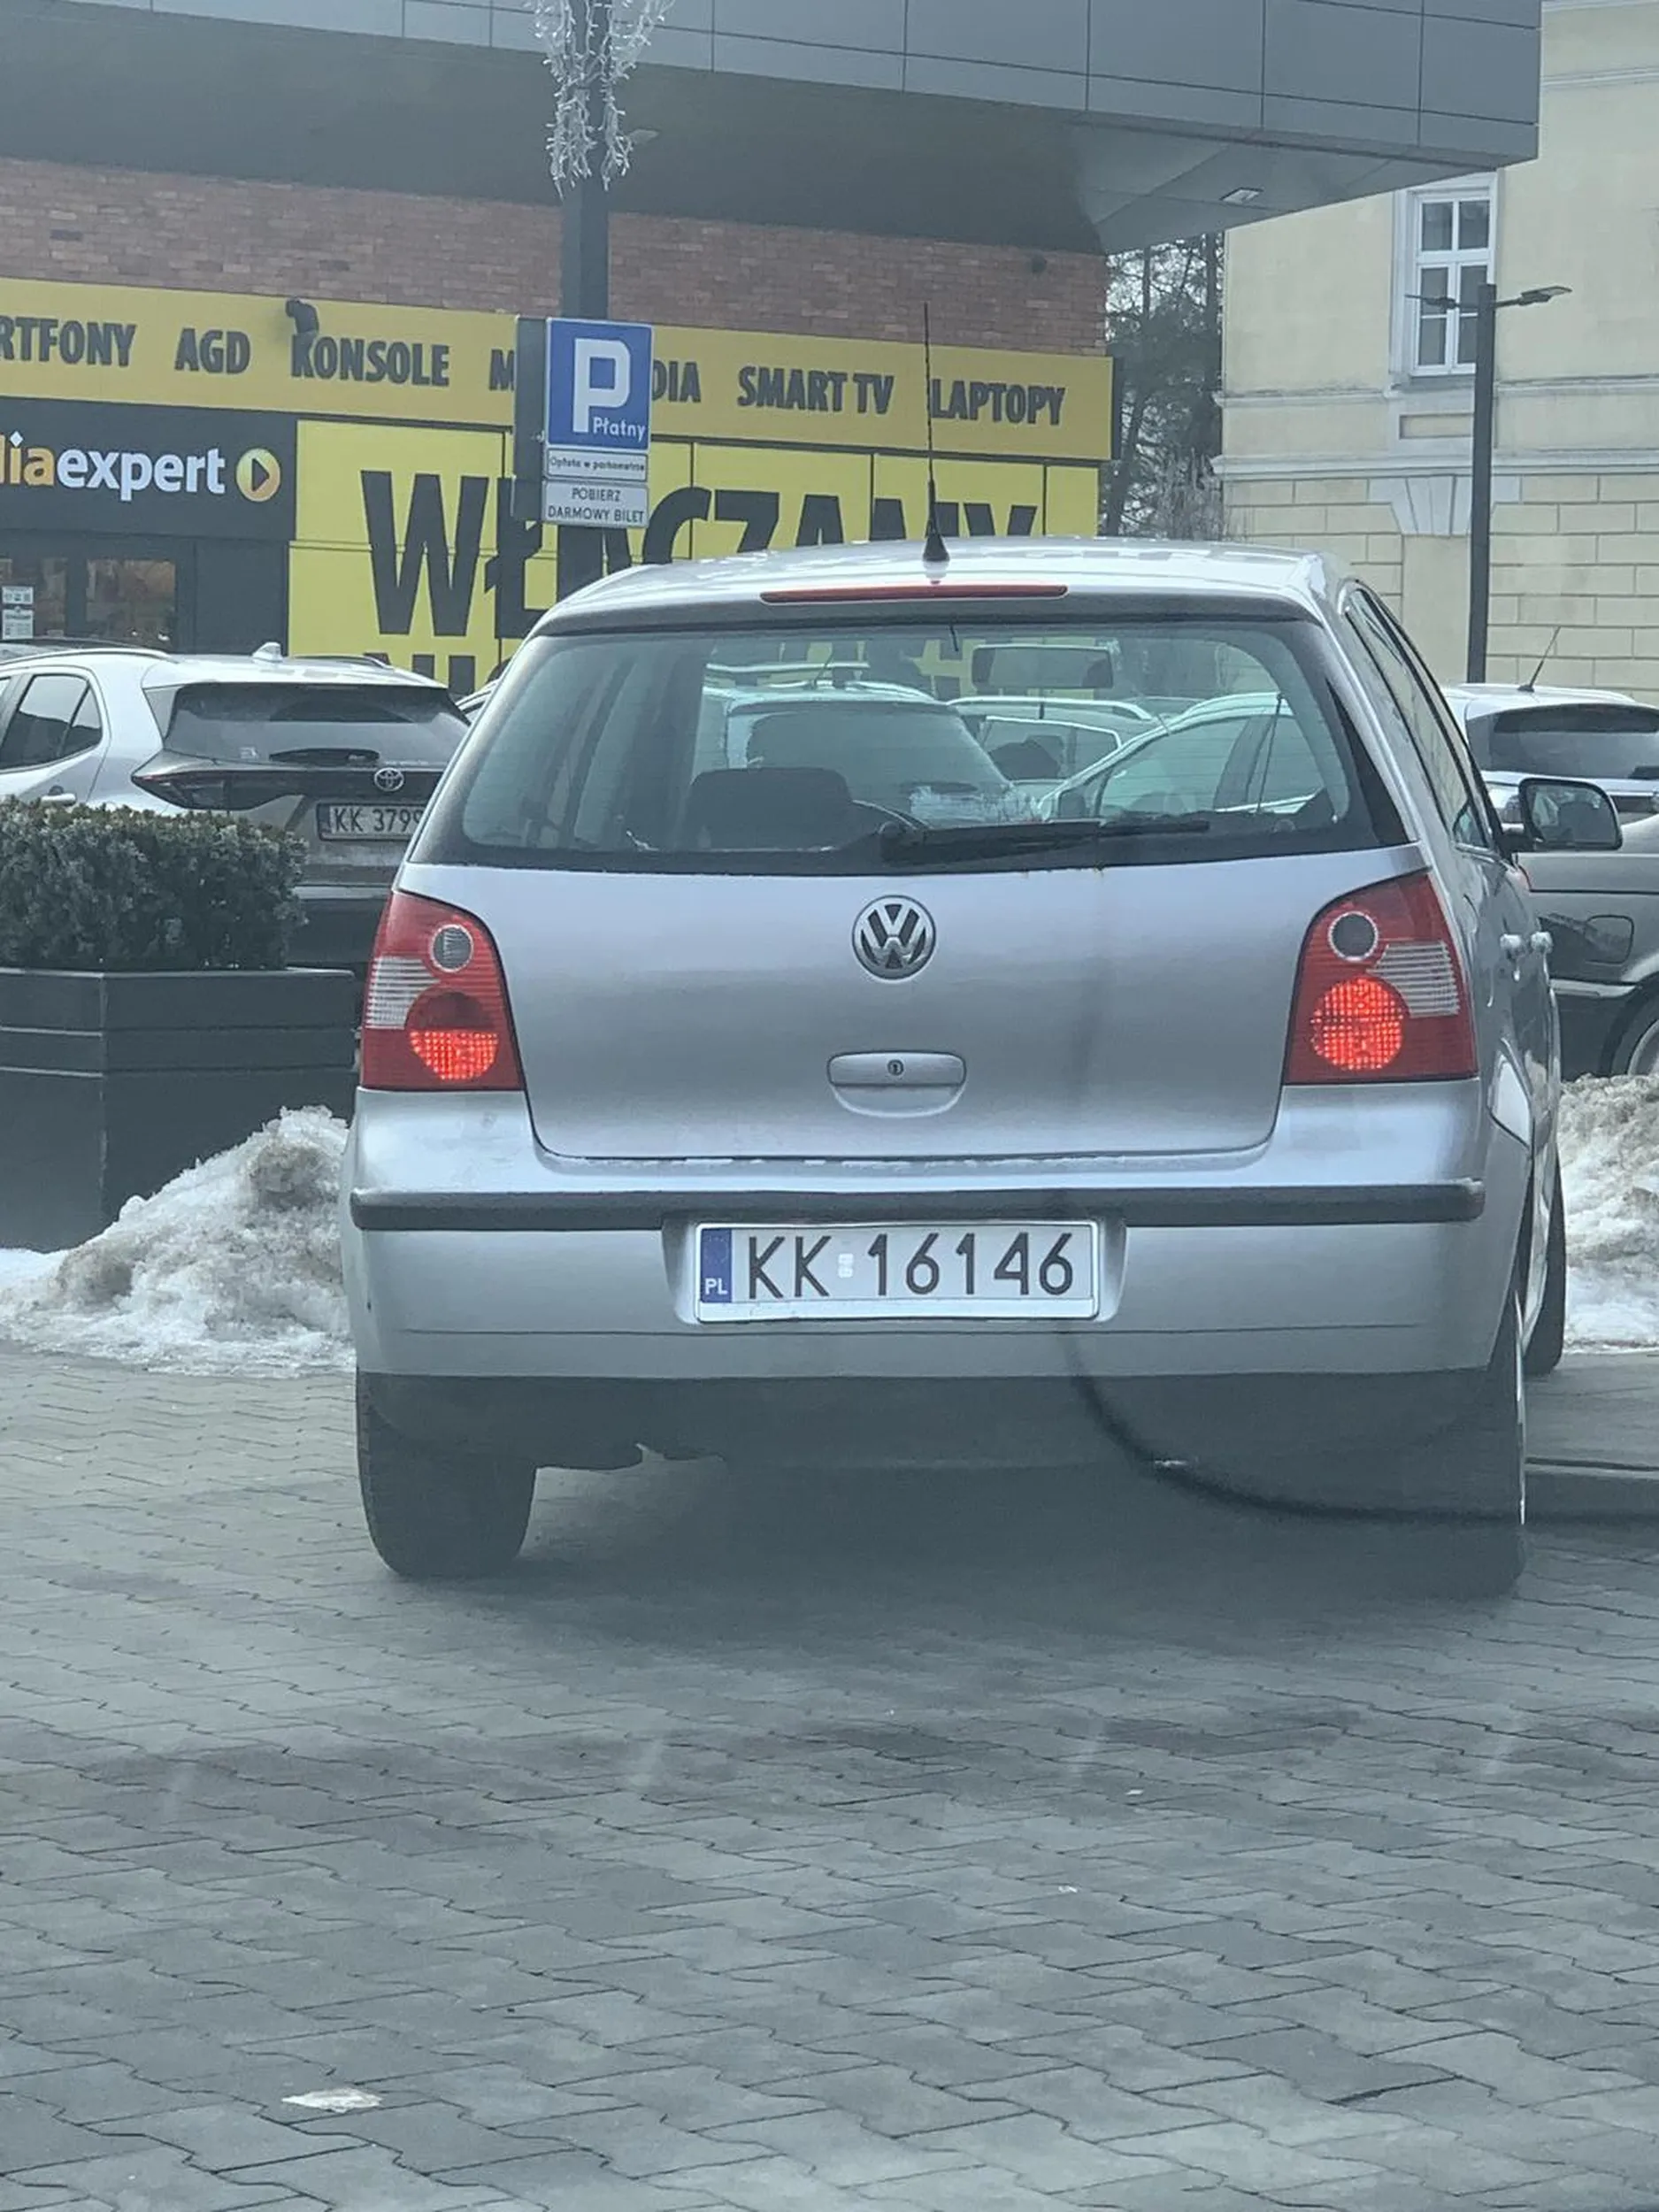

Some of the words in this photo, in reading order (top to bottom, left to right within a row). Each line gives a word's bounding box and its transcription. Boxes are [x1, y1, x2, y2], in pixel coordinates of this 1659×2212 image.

[174, 327, 250, 375] AGD
[290, 333, 449, 387] KONSOLE
[737, 365, 848, 412] SMART
[852, 373, 895, 414] TV
[931, 379, 1065, 426] LAPTOPY
[573, 338, 631, 433] P
[593, 417, 646, 442] Płatny
[0, 430, 226, 502] iaexpert
[572, 487, 621, 503] POBIERZ
[548, 505, 610, 520] DARMOWY
[614, 509, 644, 524] BILET
[334, 808, 364, 832] KK
[749, 1235, 832, 1299] KK
[868, 1233, 1073, 1296] 16146
[704, 1278, 728, 1295] PL
